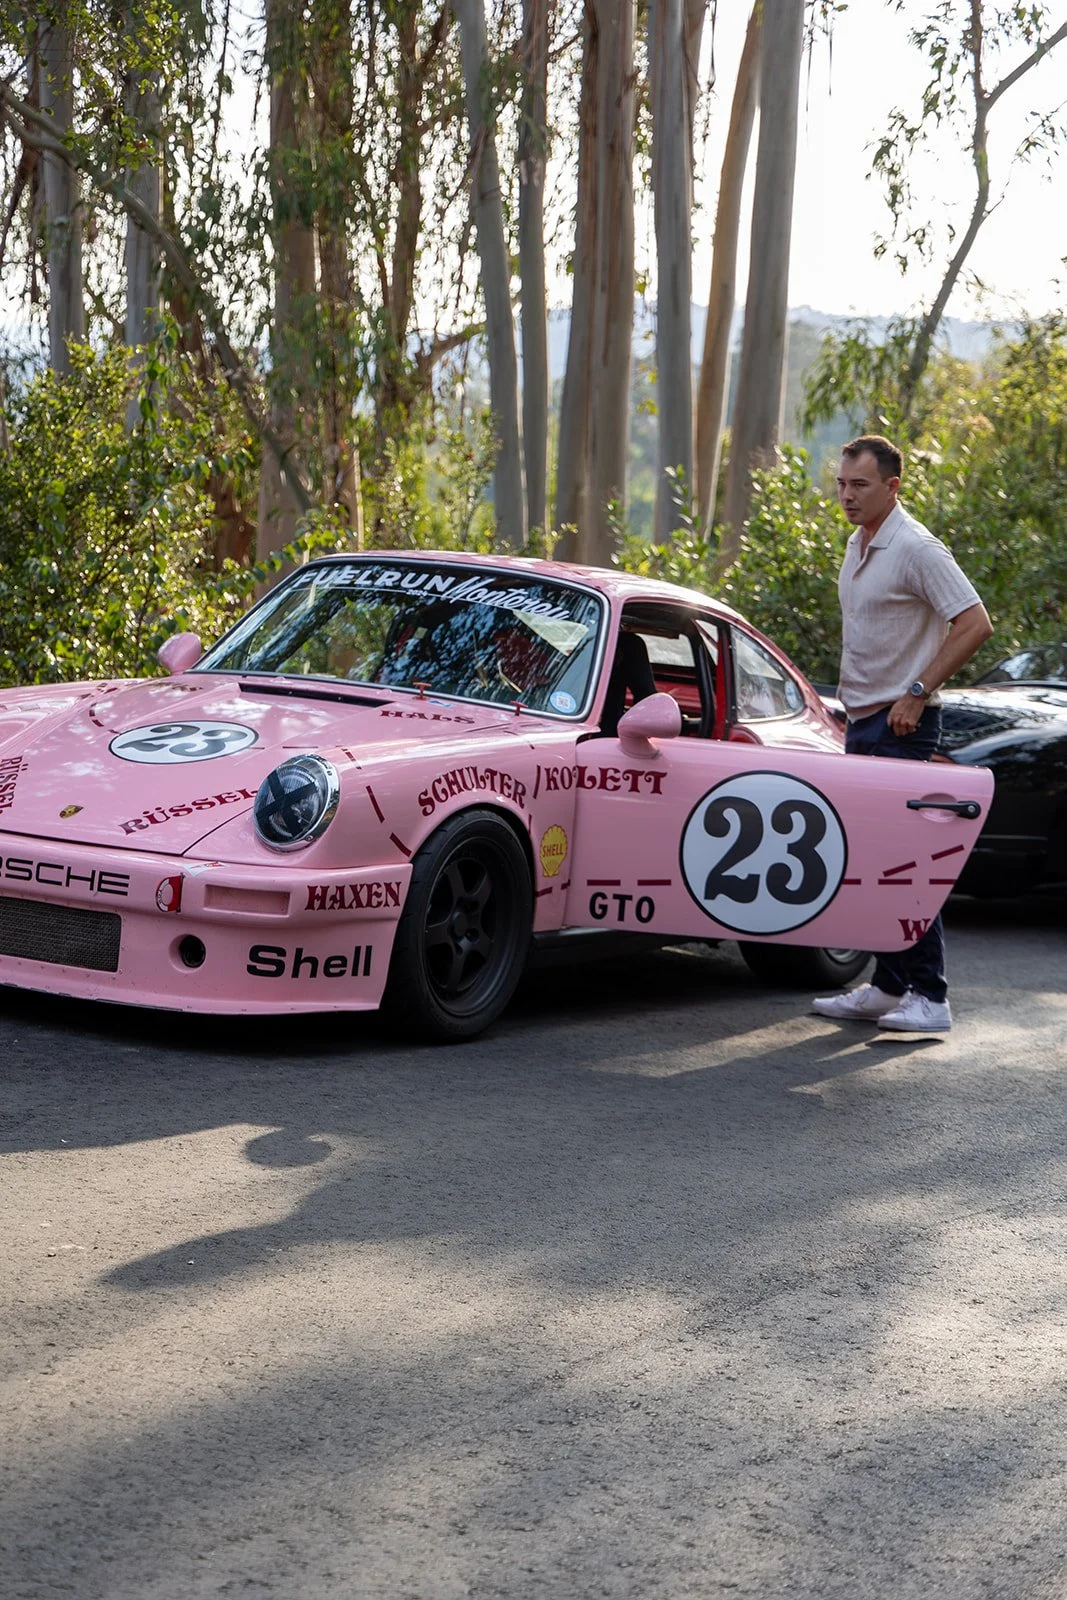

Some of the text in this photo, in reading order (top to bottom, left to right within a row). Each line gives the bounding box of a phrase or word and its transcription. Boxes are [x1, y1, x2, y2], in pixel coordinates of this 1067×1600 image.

[293, 565, 456, 592] FUELRUN
[380, 709, 476, 725] HALS
[117, 724, 248, 758] 23
[418, 766, 527, 817] SCHULTER
[542, 843, 564, 857] SHELL
[703, 795, 827, 905] 23
[0, 855, 130, 896] SCHE
[304, 881, 402, 911] HAXEN
[589, 892, 655, 923] GTO
[246, 944, 373, 979] Shell
